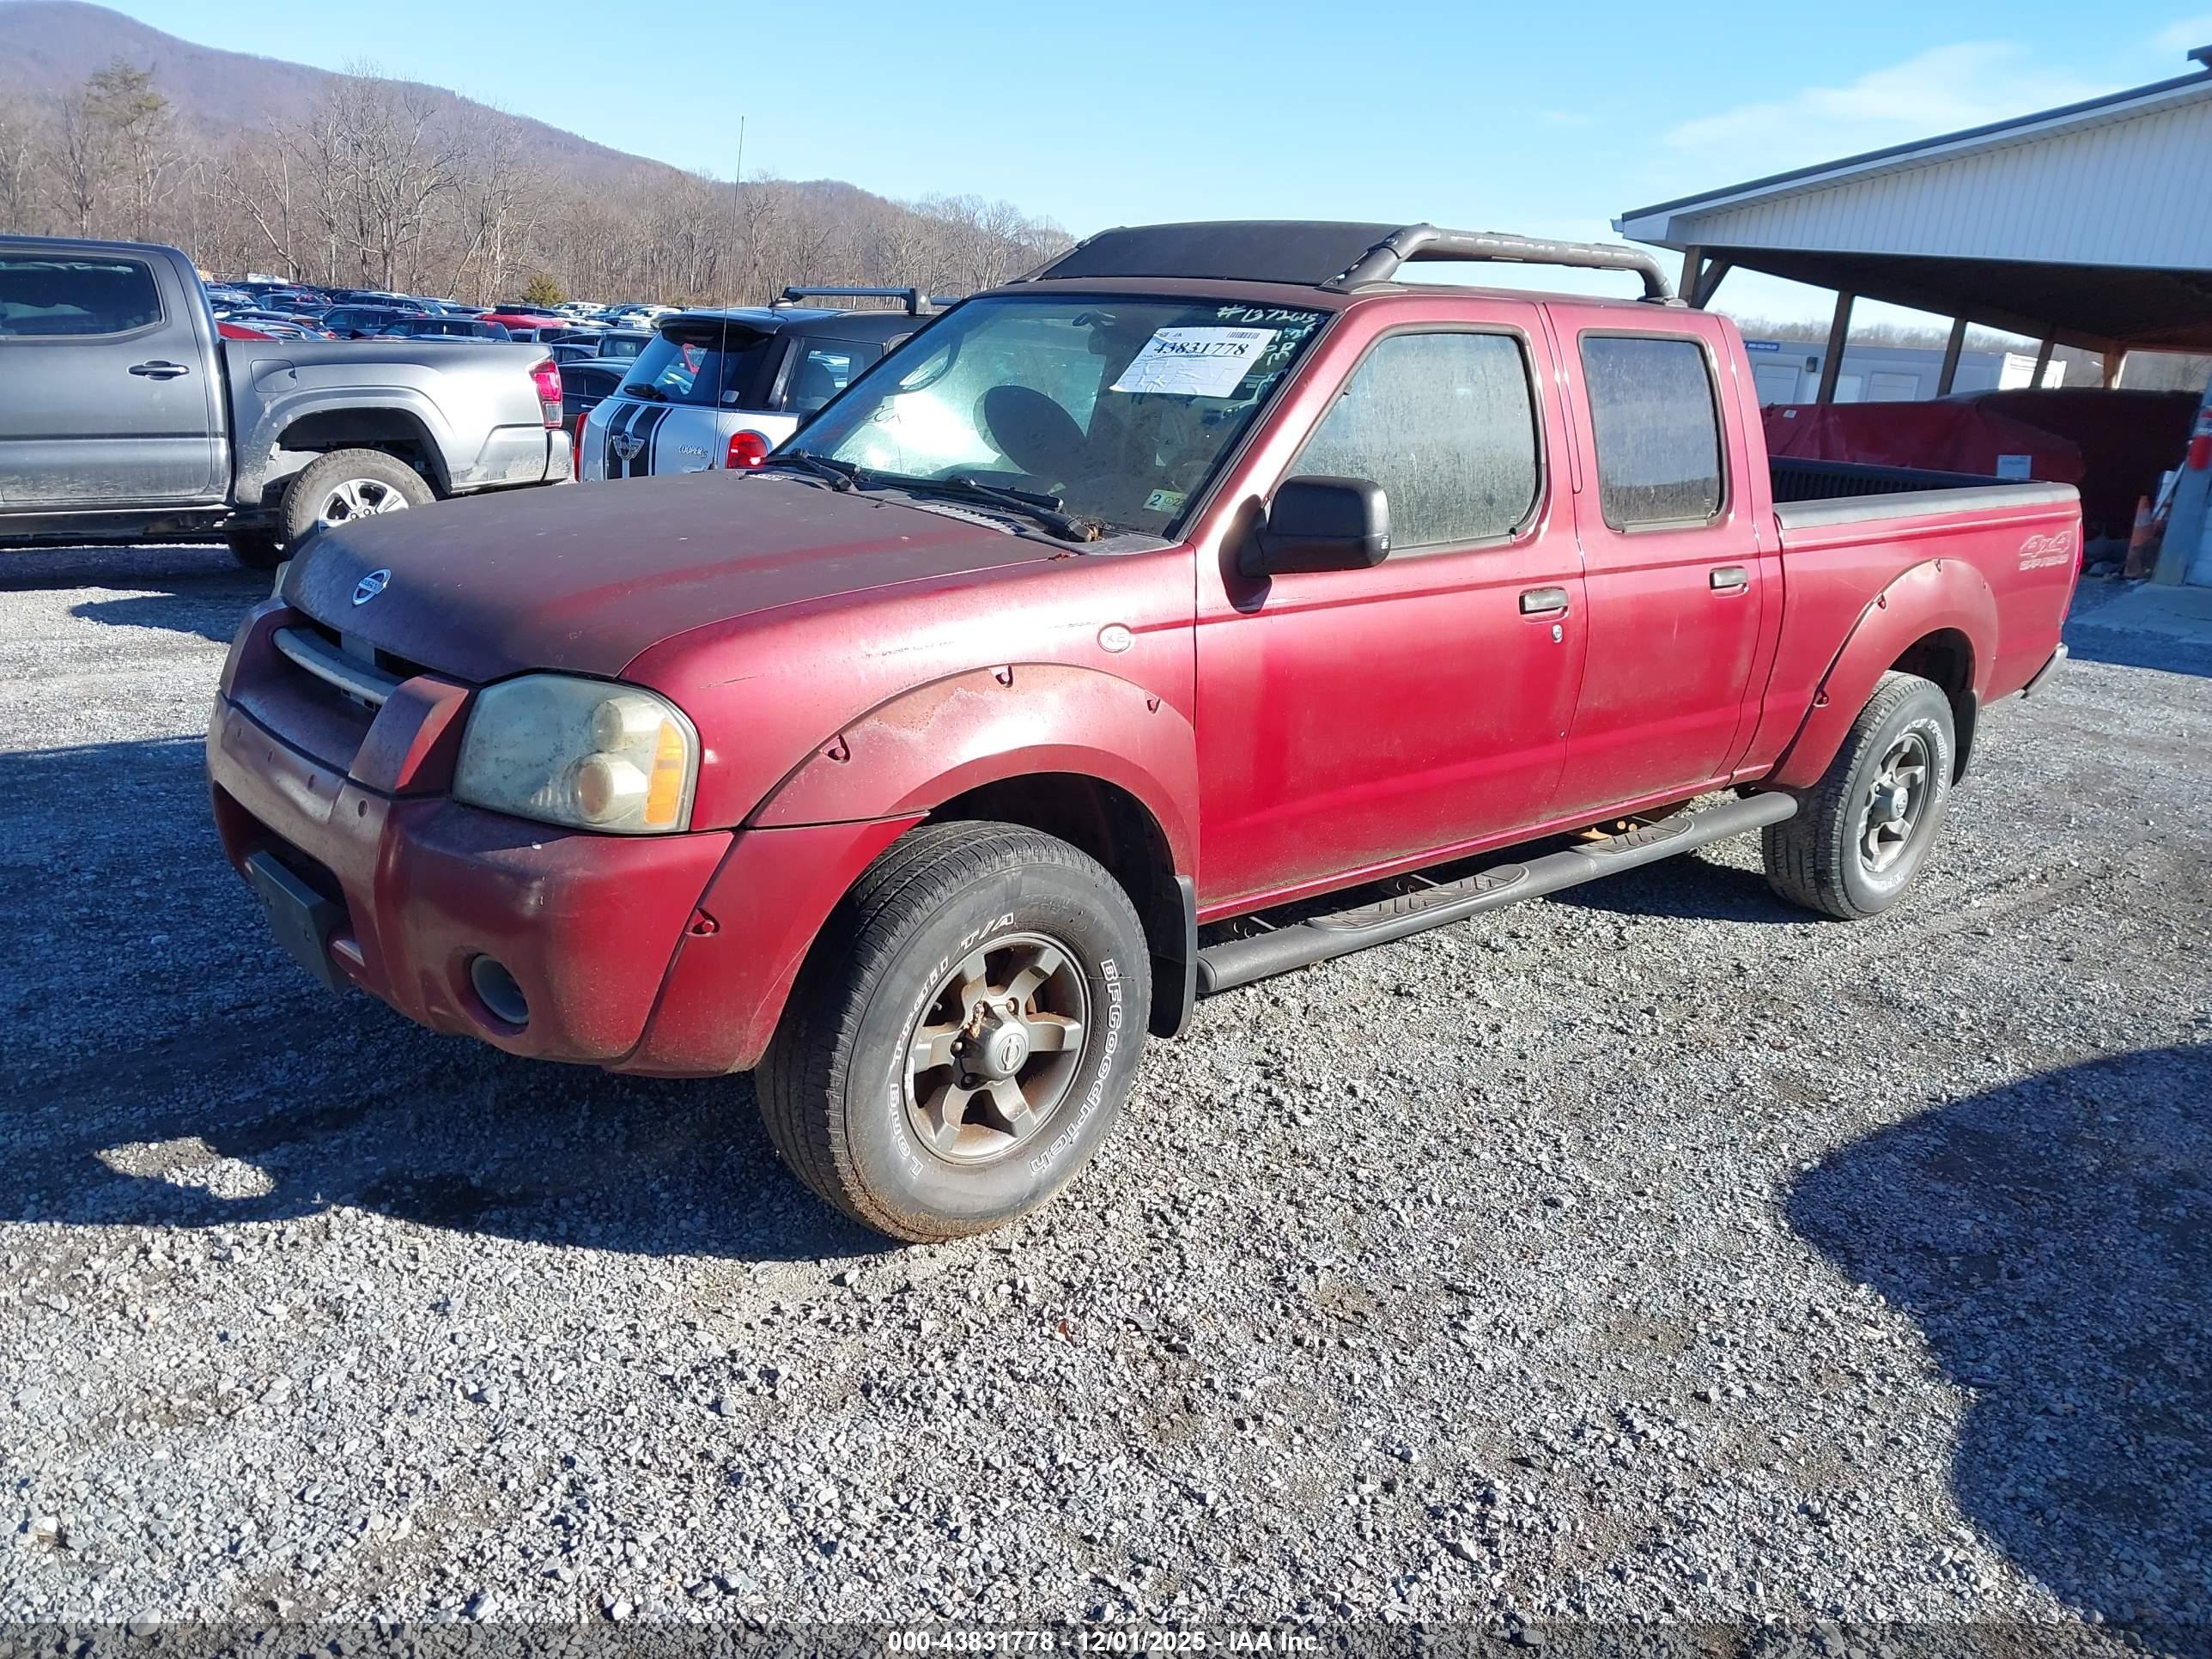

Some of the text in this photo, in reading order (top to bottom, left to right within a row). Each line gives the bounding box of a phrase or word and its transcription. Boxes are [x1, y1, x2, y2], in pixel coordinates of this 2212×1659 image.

[1153, 342, 1249, 356] 43831778
[678, 446, 703, 455] COOPER
[1148, 494, 1162, 507] 2
[961, 912, 1015, 951] T/A
[1030, 957, 1121, 1176] BFGoodrich
